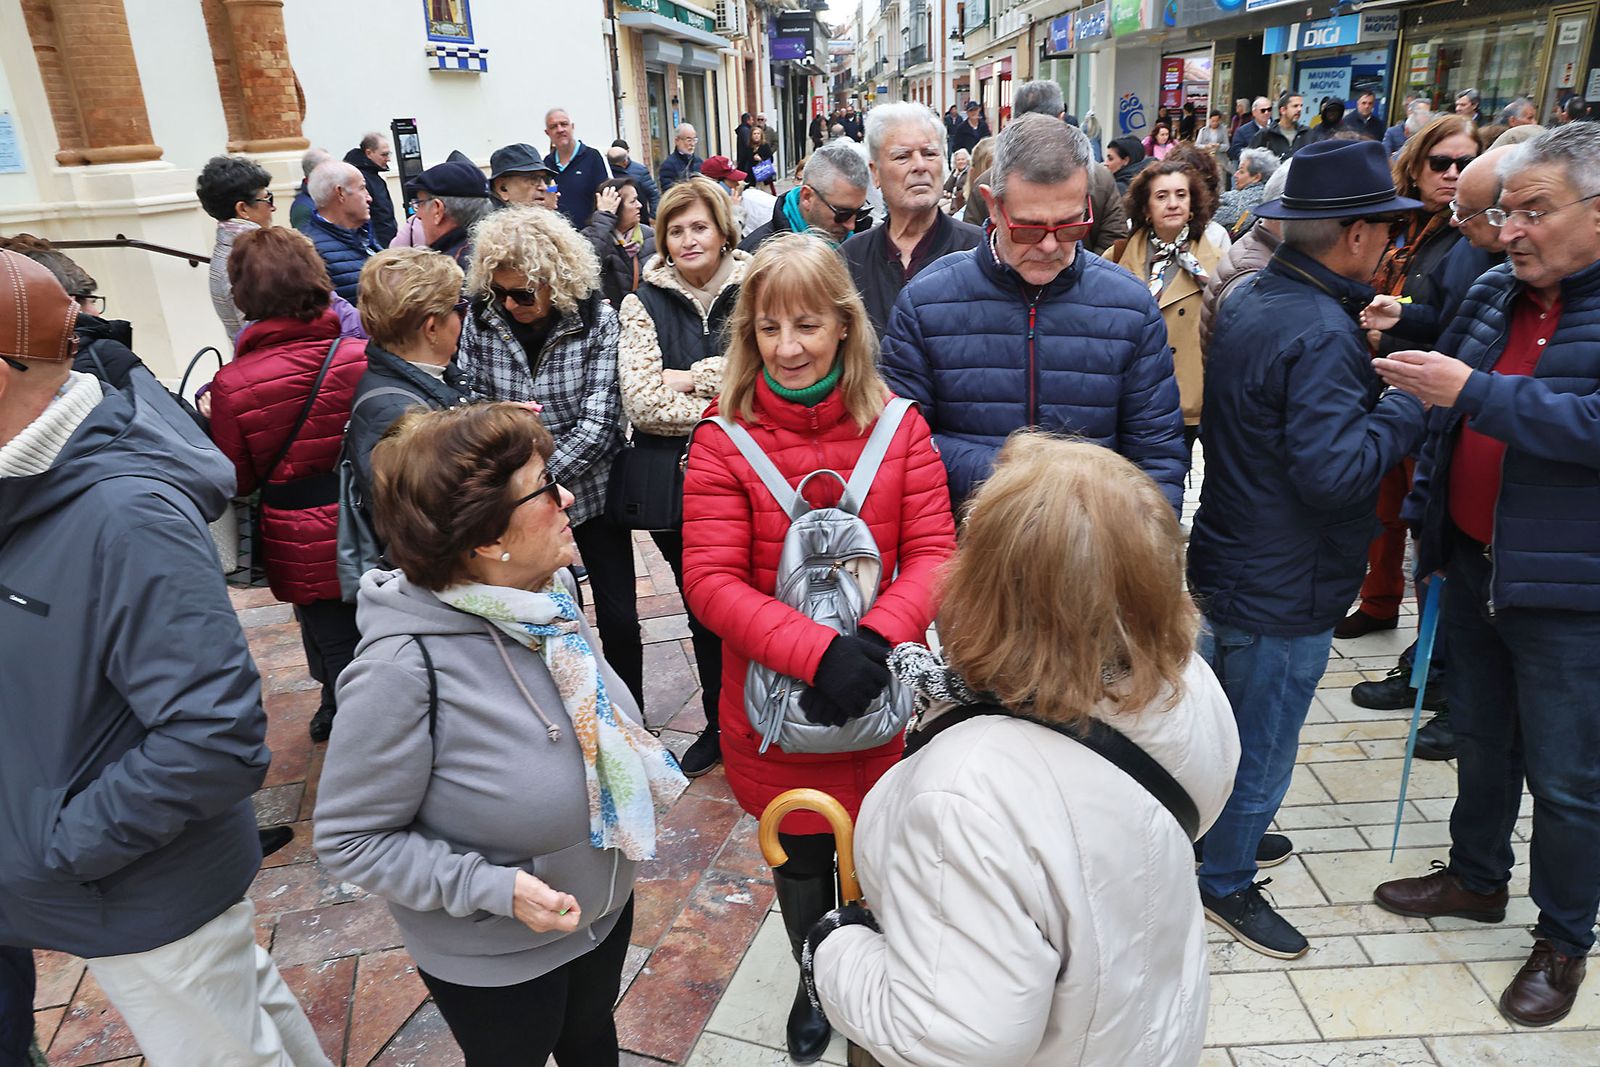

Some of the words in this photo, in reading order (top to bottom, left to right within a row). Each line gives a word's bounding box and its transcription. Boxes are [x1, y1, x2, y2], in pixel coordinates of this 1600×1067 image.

[1365, 15, 1398, 23] MUNDO
[1304, 27, 1340, 47] DIGI
[1308, 70, 1346, 79] MUNDO
